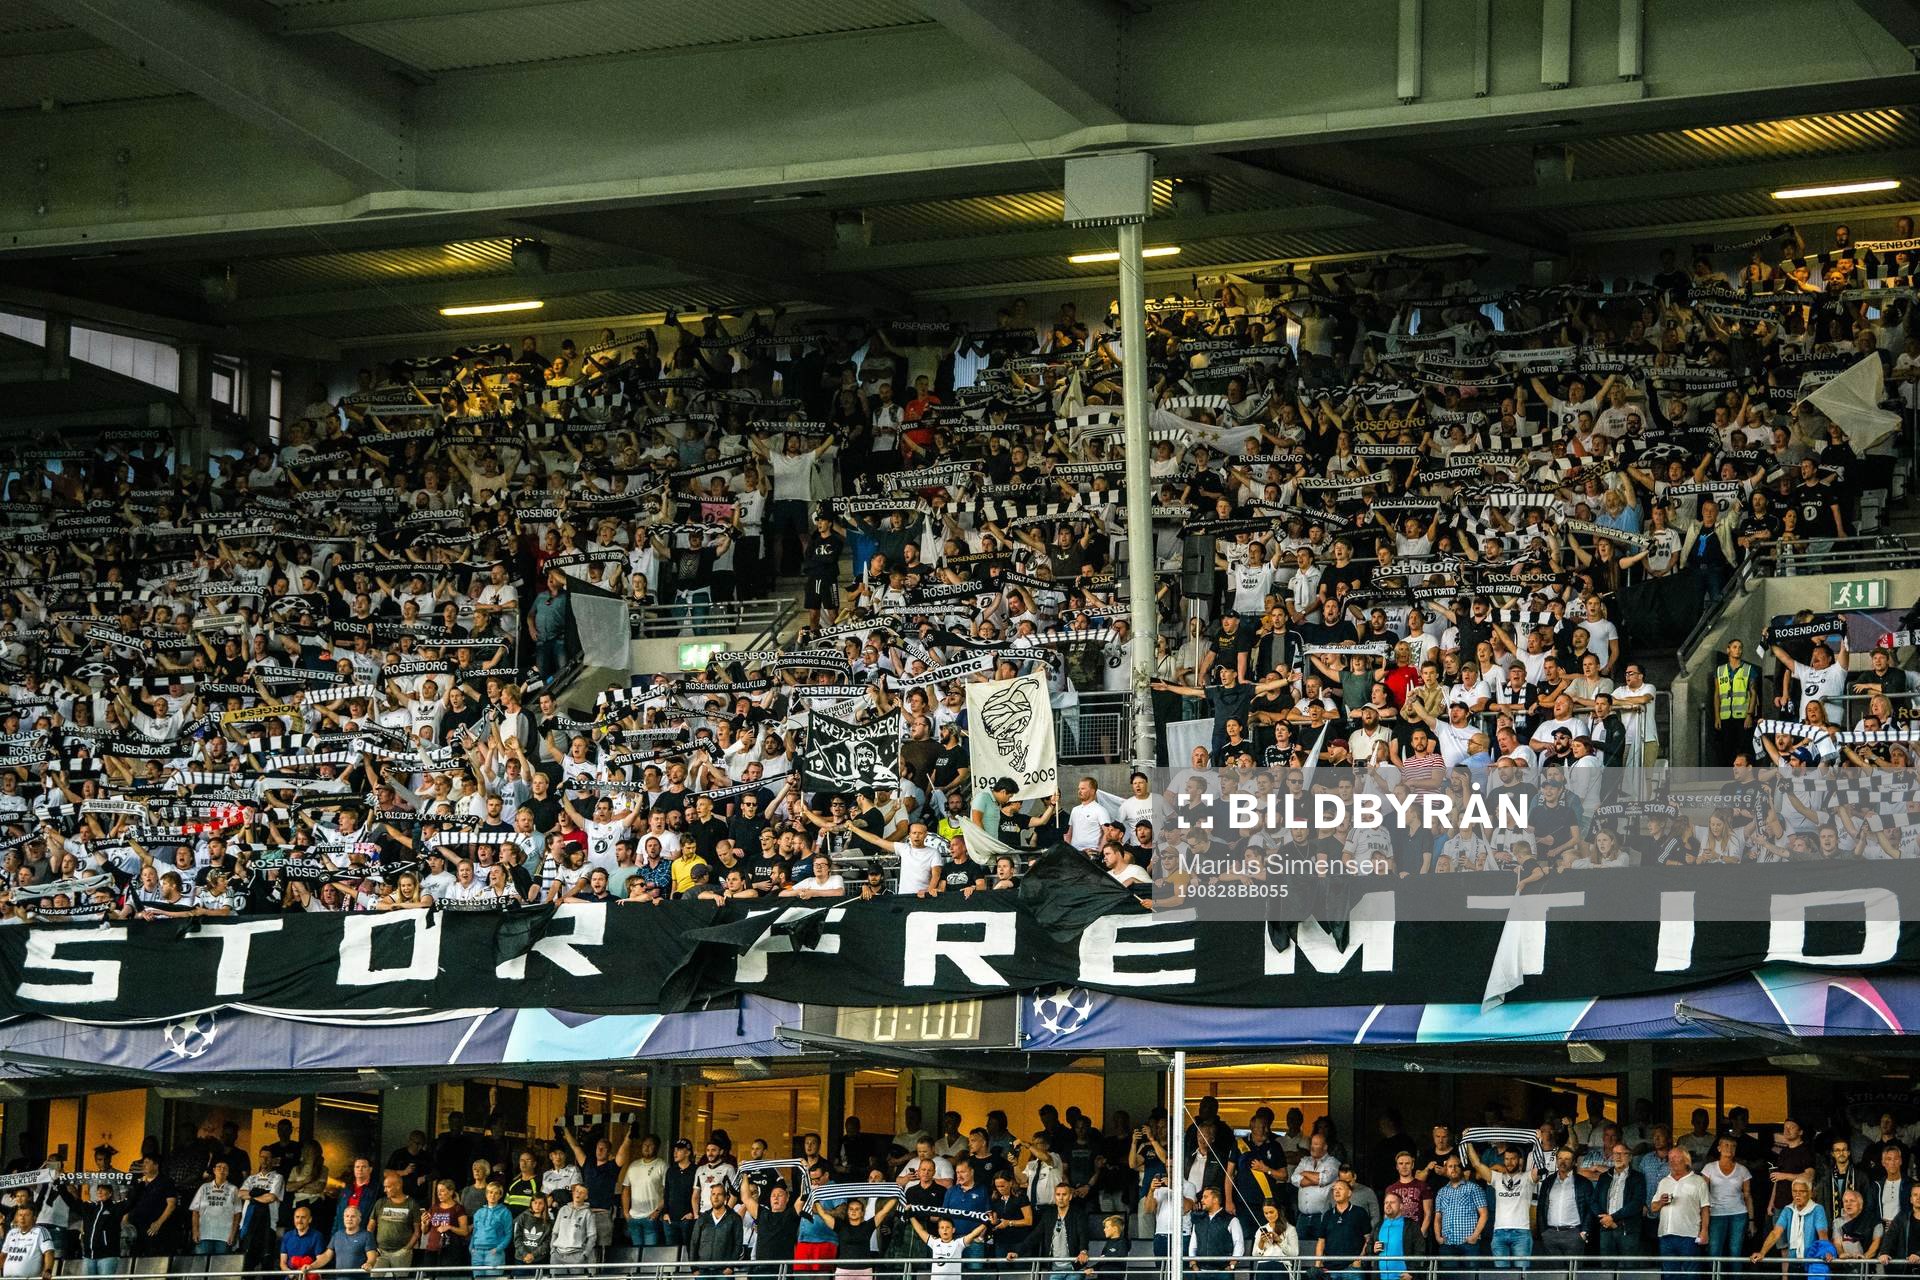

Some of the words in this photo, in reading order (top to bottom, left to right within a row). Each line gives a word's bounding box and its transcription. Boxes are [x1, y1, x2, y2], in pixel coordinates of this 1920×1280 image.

[1704, 307, 1778, 319] ROSENBOR
[892, 321, 950, 331] ROSENBORG
[1780, 353, 1838, 362] KJERNEN
[1686, 380, 1738, 390] ROSENBORG
[954, 424, 1020, 433] ROSENBORG
[1353, 418, 1425, 432] ROSENBORG
[104, 430, 160, 441] ROSENBORG
[359, 429, 434, 444] ROSENBORG
[1354, 446, 1417, 455] ROSENBORG
[1239, 453, 1304, 463] ROSENBORG
[1056, 462, 1123, 476] ROSENBORG
[1420, 467, 1481, 482] ROSENBORG
[1304, 473, 1382, 487] ROSENBORG
[853, 500, 917, 511] ROSENBORG
[1373, 497, 1437, 507] ROSENBORG
[58, 516, 111, 528] ROSENBORG
[217, 525, 273, 538] ROSENBOR
[552, 557, 574, 568] FORTID
[590, 553, 607, 564] STOR
[947, 554, 994, 564] ROSENBORG
[1006, 571, 1027, 584] STOLT
[1026, 576, 1051, 588] FORTID
[1488, 572, 1556, 584] ROSENBORG
[201, 585, 265, 598] ROSENBORG
[922, 581, 983, 599] ROSENBORG
[1414, 588, 1434, 600] STOLT
[1433, 586, 1456, 598] FORTID
[1476, 585, 1495, 594] STOR
[1496, 584, 1522, 594] FREMTID
[333, 620, 369, 634] ROSEN
[819, 616, 893, 640] ROSENBORG
[1774, 623, 1831, 638] ROSENBORG
[264, 666, 344, 683] ROSENBORG
[386, 661, 448, 676] ROSENBORG
[461, 668, 519, 679] ROSENBORG
[897, 662, 983, 686] ROSENBORG
[685, 682, 729, 693] ROSENBORG
[731, 680, 767, 692] BALLKLUB
[112, 742, 171, 757] ROSENBORG
[676, 741, 694, 752] STOR
[809, 759, 824, 772] 19
[974, 775, 999, 790] 199
[1023, 768, 1057, 786] 2009
[191, 800, 209, 808] STOR
[1668, 794, 1751, 803] ROSENBORG
[1597, 804, 1623, 817] FORTID
[1644, 804, 1667, 814] STOR
[1368, 842, 1388, 850] REMA
[17, 900, 608, 1003] STOR
[733, 887, 1902, 988] FREMTID
[60, 1172, 133, 1182] ROSENBORG
